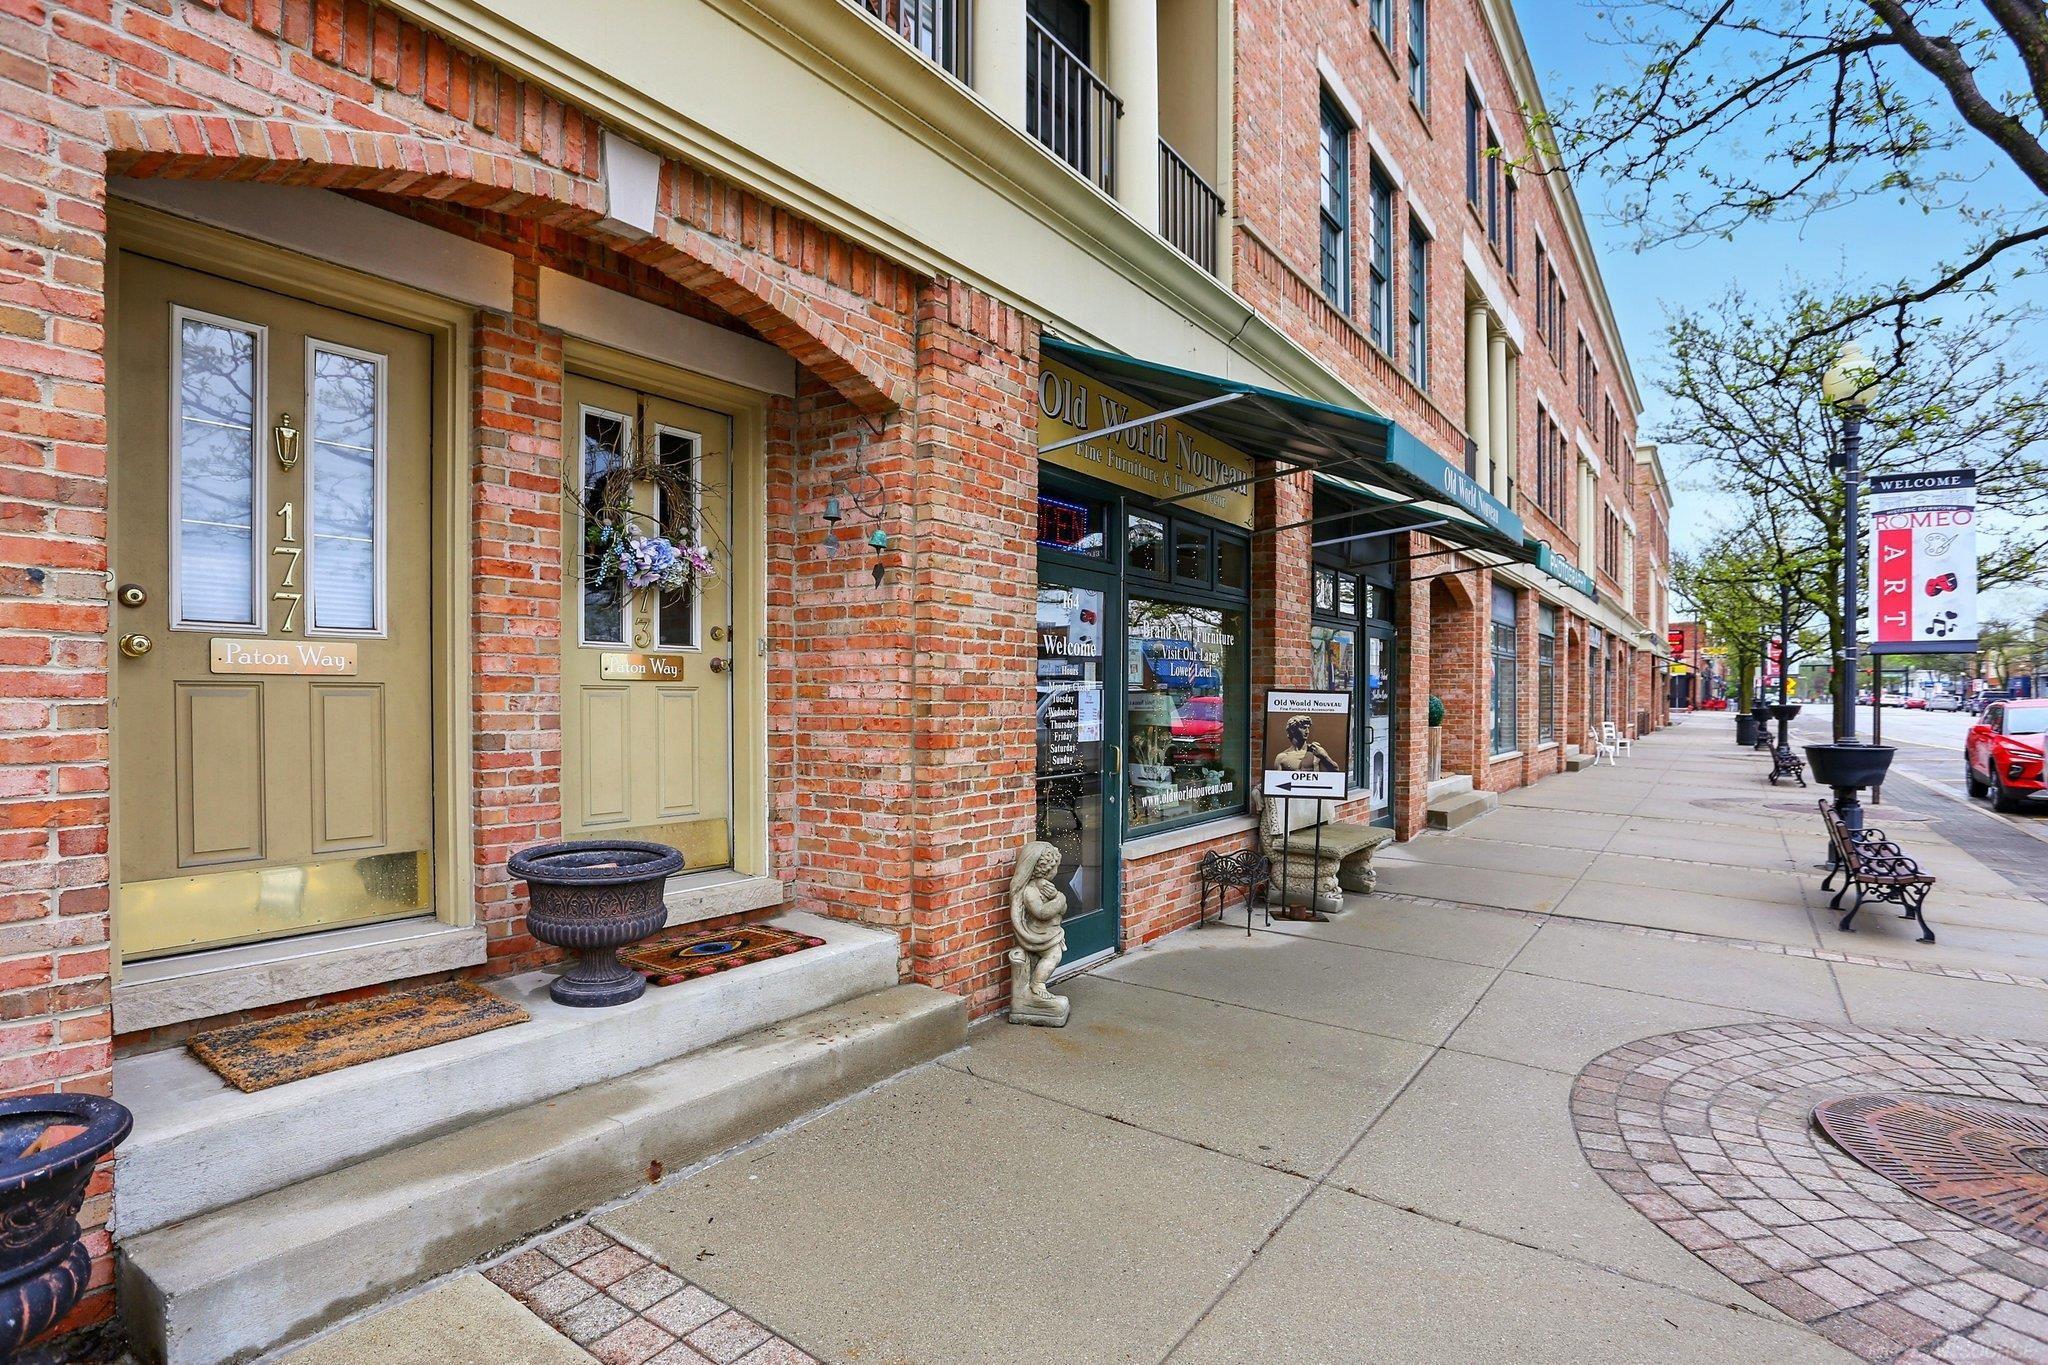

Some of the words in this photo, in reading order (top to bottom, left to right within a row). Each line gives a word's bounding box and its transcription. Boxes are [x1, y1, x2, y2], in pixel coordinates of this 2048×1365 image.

[1038, 369, 1088, 430] Old
[1098, 393, 1168, 463] World
[1175, 430, 1249, 496] Nouveau
[1075, 441, 1102, 463] Fine
[1107, 447, 1158, 483] Furniture
[1162, 470, 1171, 488] &
[1444, 466, 1457, 495] Old
[1458, 476, 1477, 508] World
[1880, 475, 1961, 490] WELCOME
[1886, 507, 1917, 515] HISTORIC
[1875, 510, 1972, 530] ROMEO
[272, 502, 302, 632] 177
[1883, 545, 1907, 626] ART
[1142, 620, 1171, 640] Brand
[1175, 624, 1193, 642] New
[1196, 627, 1235, 646] Furniture
[1043, 634, 1097, 657] Welcome
[225, 643, 289, 665] Paton
[296, 645, 346, 671] Way
[1162, 645, 1180, 659] Visit
[1183, 646, 1197, 661] Our
[1200, 648, 1220, 664] Large
[649, 657, 678, 678] Way
[1061, 665, 1079, 676] Hours
[1170, 662, 1192, 677] Lower
[1195, 664, 1212, 678] Level
[1052, 694, 1074, 705] Tuesday
[1289, 699, 1311, 707] World
[1047, 707, 1078, 718] Wednesday
[1050, 720, 1076, 730] Thursday
[1053, 731, 1073, 742] Friday
[1050, 743, 1076, 753] Saturday
[1052, 755, 1073, 765] Sunday
[1291, 772, 1319, 781] OPEN
